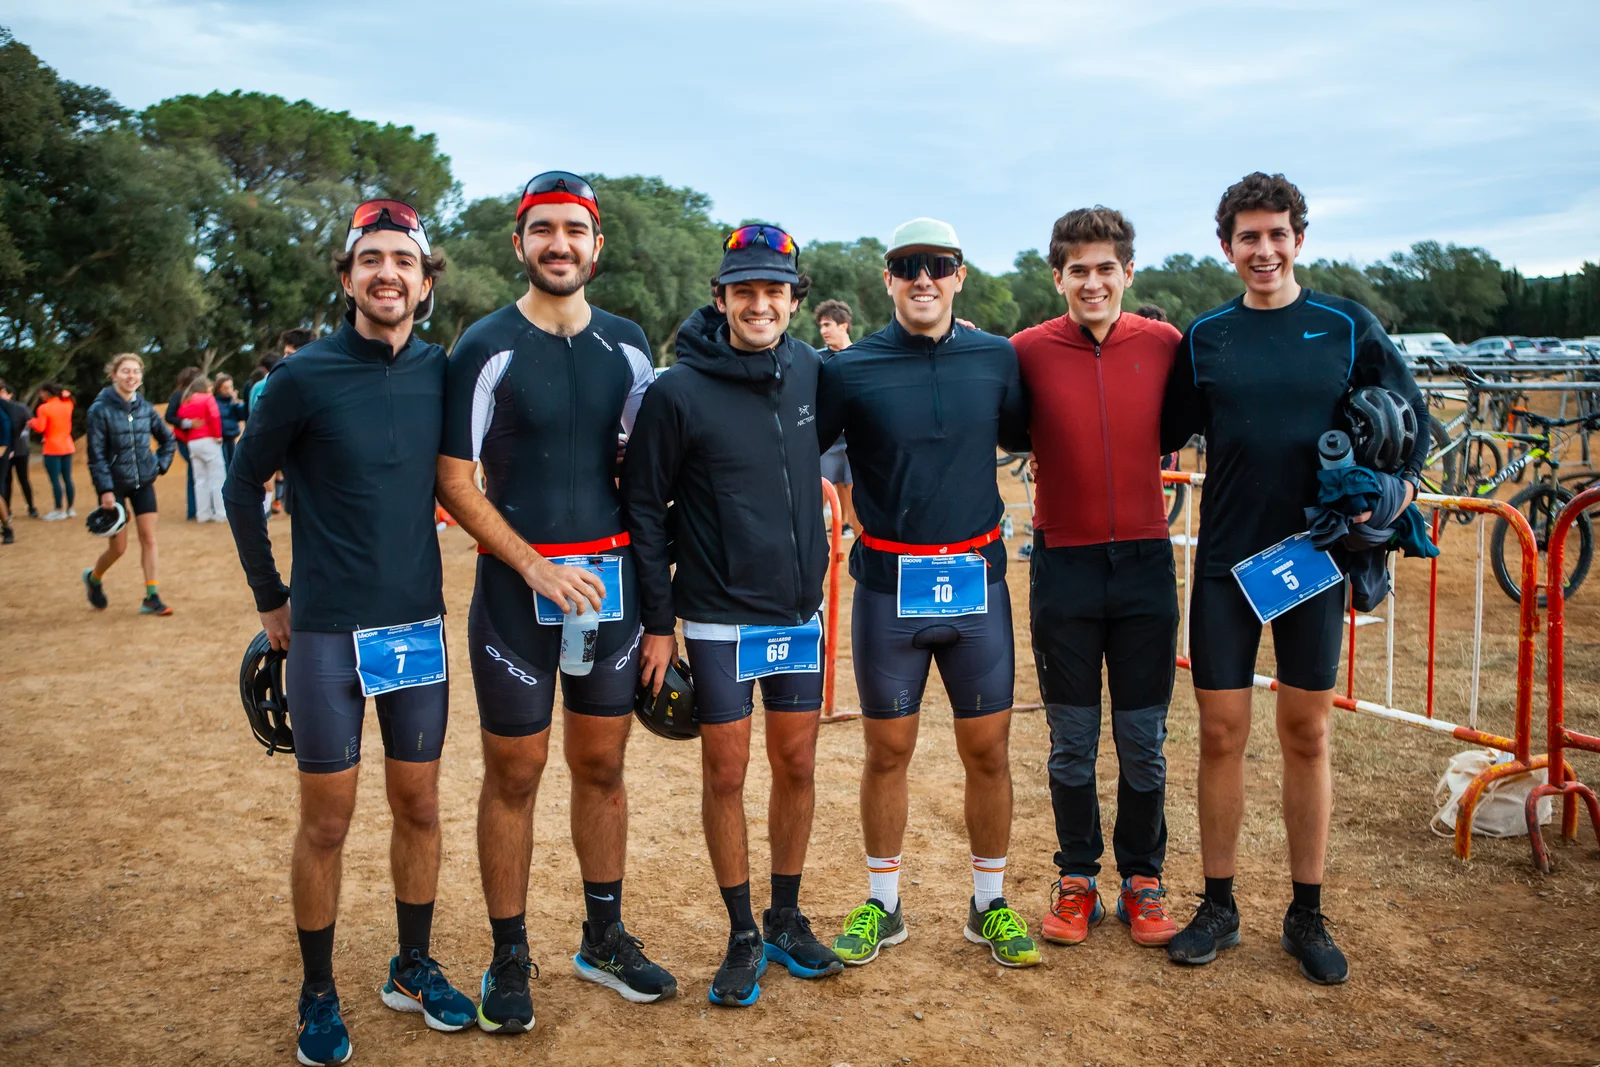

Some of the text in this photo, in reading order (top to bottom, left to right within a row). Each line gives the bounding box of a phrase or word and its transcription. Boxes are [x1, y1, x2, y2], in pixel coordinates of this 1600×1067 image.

[592, 331, 613, 352] orca
[1281, 570, 1300, 591] 5
[932, 583, 953, 603] 10
[395, 653, 406, 674] 7
[767, 643, 789, 663] 69
[485, 644, 538, 686] orca
